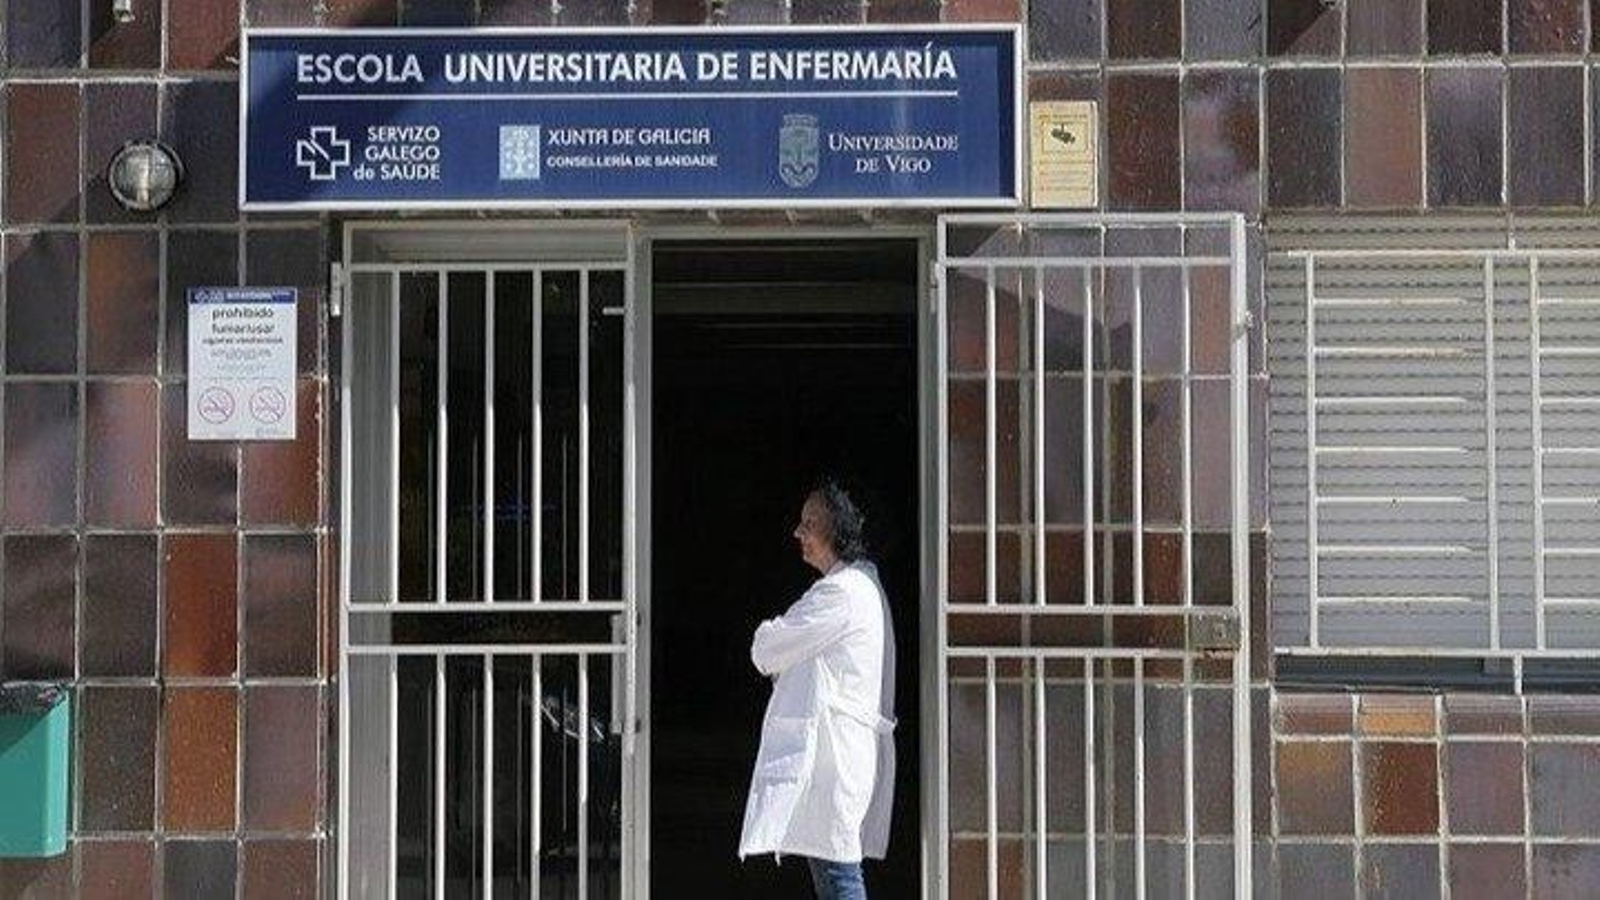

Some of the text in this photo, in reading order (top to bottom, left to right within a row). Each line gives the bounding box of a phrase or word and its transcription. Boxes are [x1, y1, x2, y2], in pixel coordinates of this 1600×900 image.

[297, 42, 957, 83] ESCOLA UNIVERSITARIA DE ENFERMARÍA
[367, 126, 441, 142] SERVIZO
[548, 128, 710, 145] XUNTA DE GALICIA
[365, 146, 441, 161] GALEGO
[547, 154, 718, 167] CONSELLERÍA DE SANIDADE
[353, 161, 441, 180] de SAÚDE
[212, 306, 274, 321] prohibido
